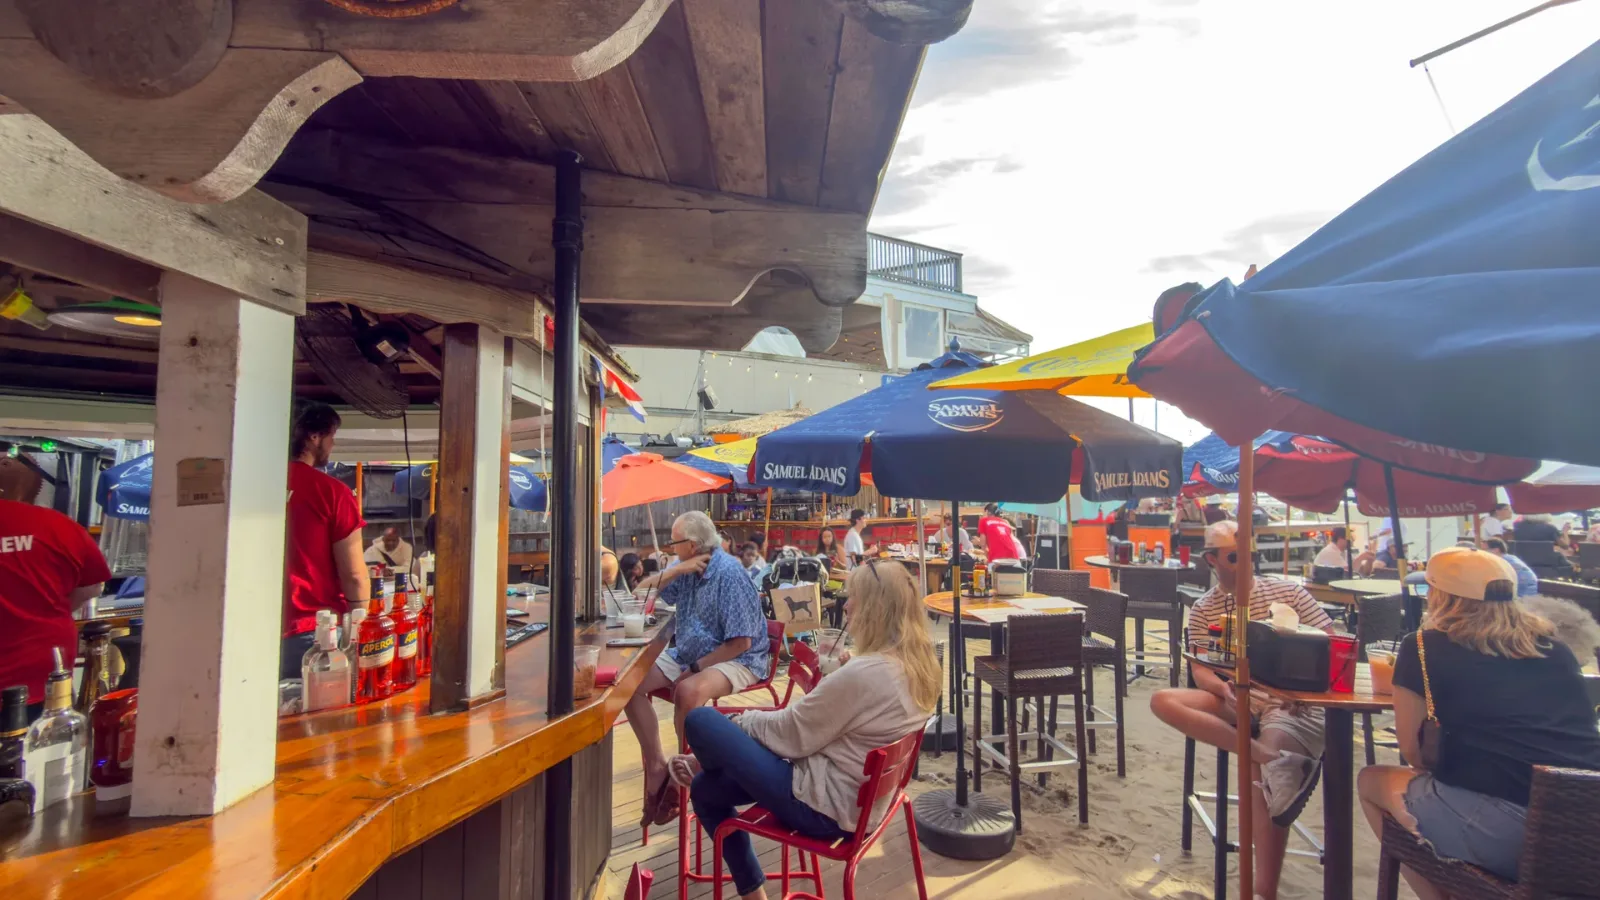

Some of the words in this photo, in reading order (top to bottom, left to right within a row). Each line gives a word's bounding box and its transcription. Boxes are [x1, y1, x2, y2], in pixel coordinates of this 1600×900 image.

[928, 403, 1004, 413] SAMUEL
[934, 410, 998, 419] ADAMS
[763, 462, 808, 480] SAMUEL
[809, 465, 847, 486] ADAMS
[1094, 471, 1132, 494] SAMUEL
[1132, 469, 1171, 489] ADAMS
[1423, 500, 1477, 514] ADAMS
[0, 535, 34, 553] EW
